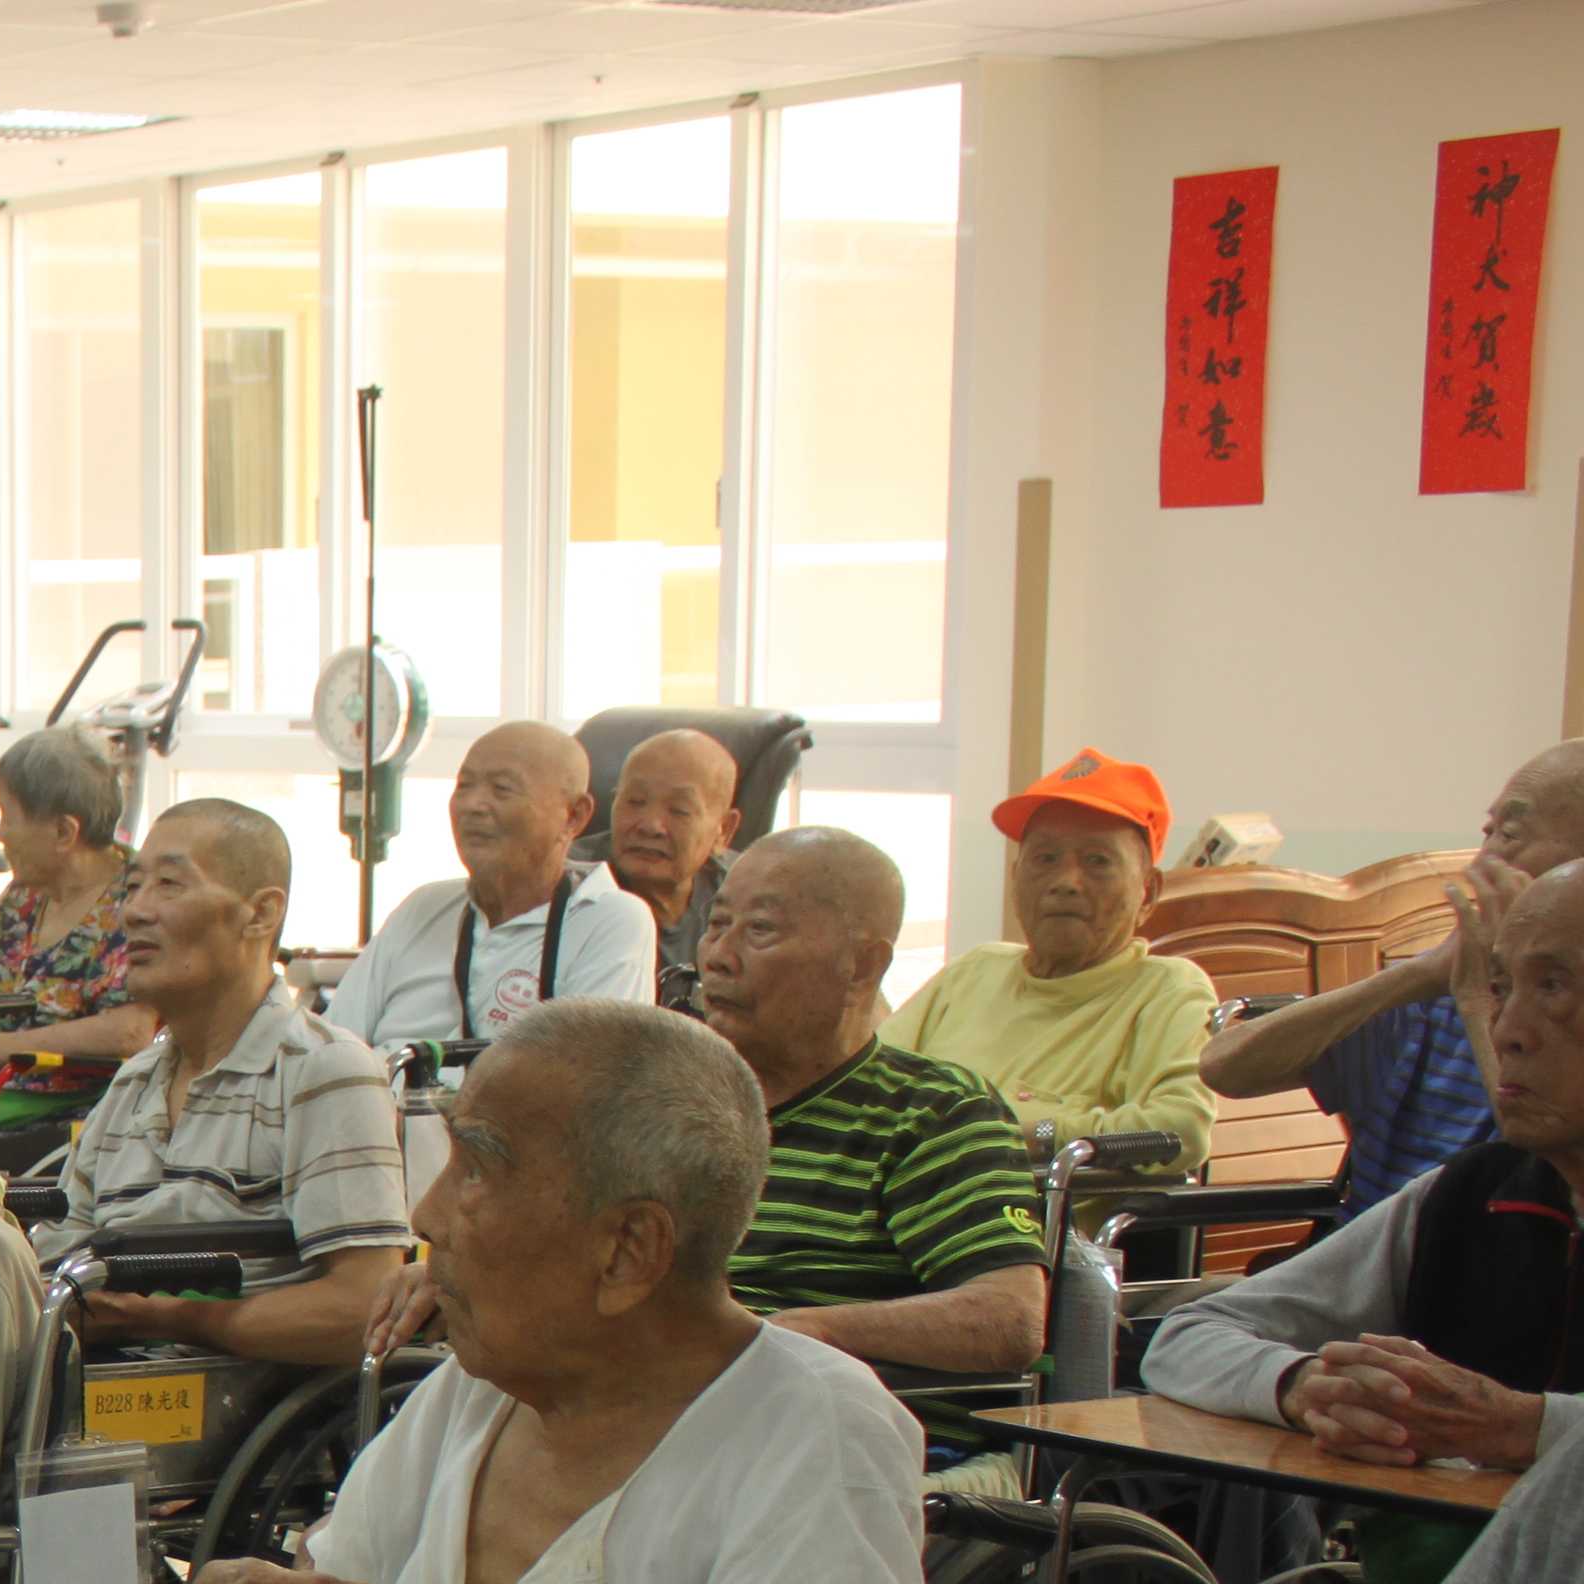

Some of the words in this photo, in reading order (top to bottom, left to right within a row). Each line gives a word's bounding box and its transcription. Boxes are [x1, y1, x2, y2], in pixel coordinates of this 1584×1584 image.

[1198, 196, 1247, 461] 吉祥如意
[95, 1393, 133, 1415] B228
